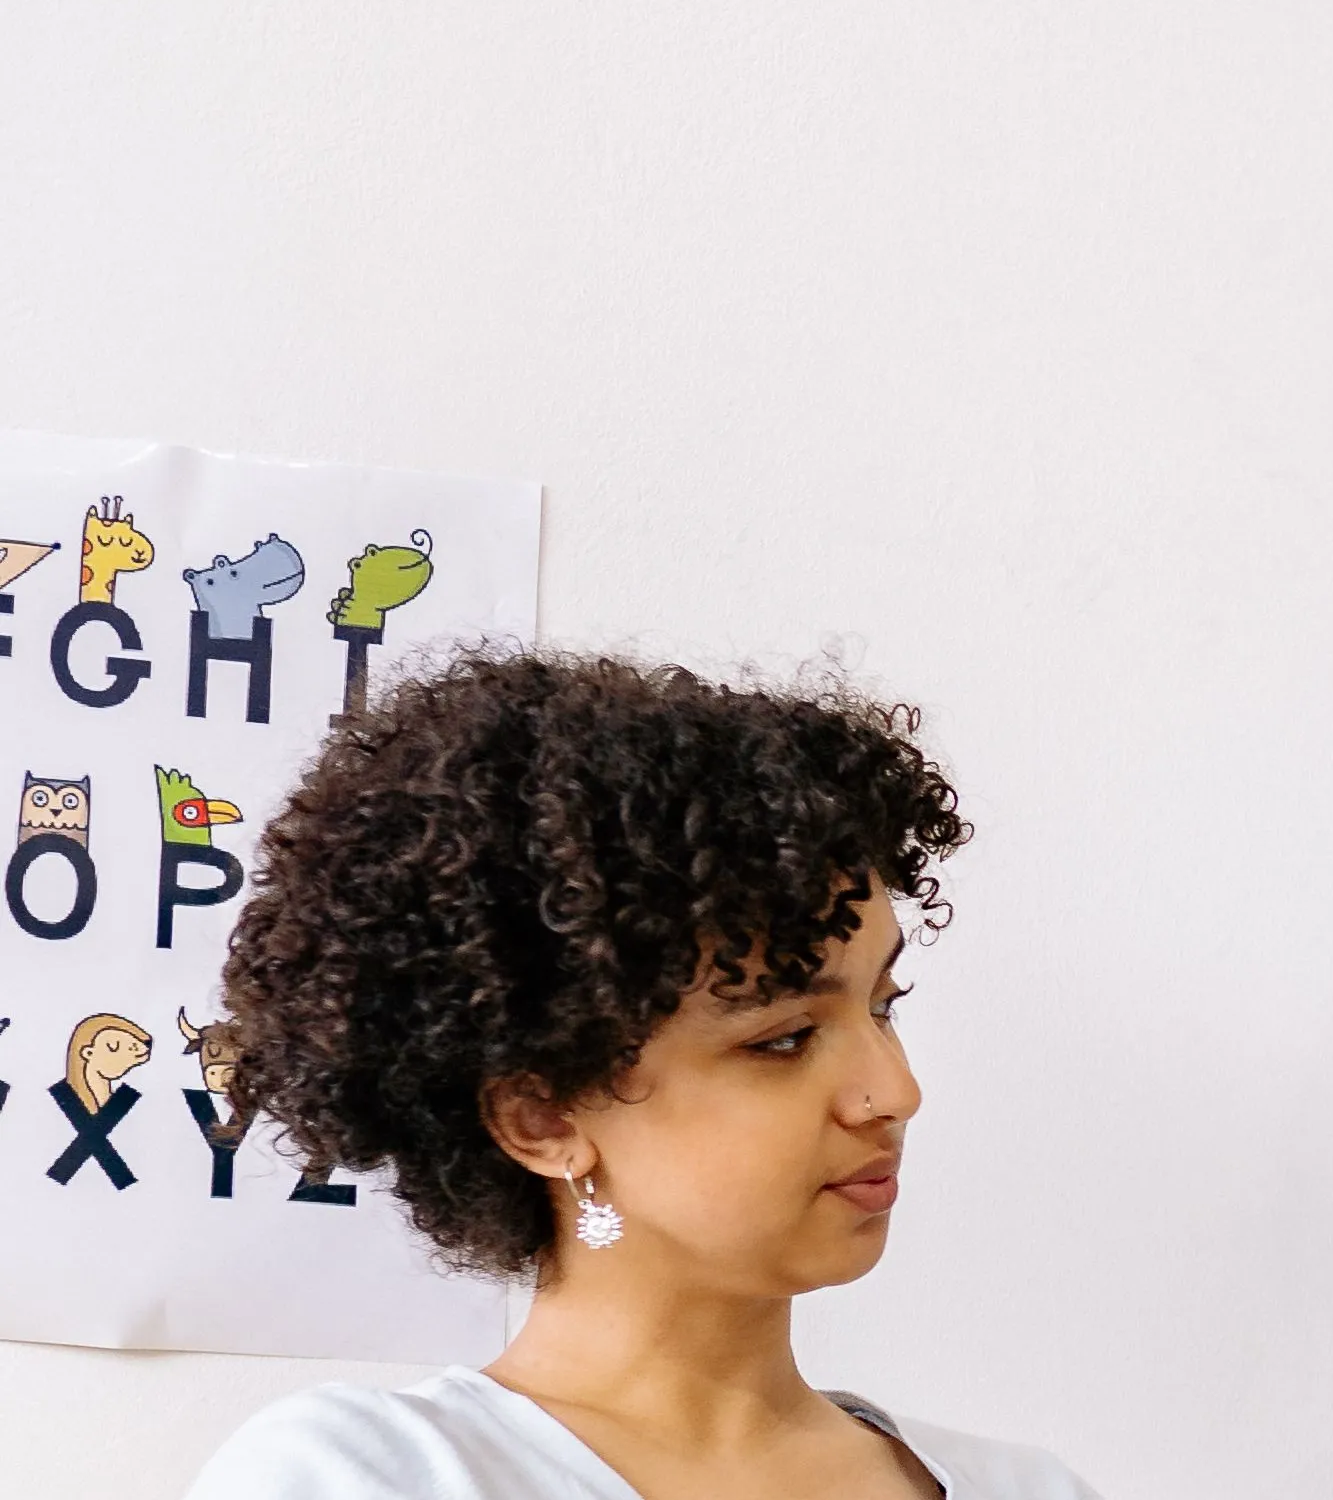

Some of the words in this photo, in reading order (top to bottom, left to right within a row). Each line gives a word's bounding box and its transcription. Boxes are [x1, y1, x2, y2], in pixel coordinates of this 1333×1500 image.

[50, 600, 152, 708] G
[185, 609, 273, 724] H
[5, 833, 97, 940] O
[156, 838, 244, 949] P
[46, 1077, 142, 1190] X
